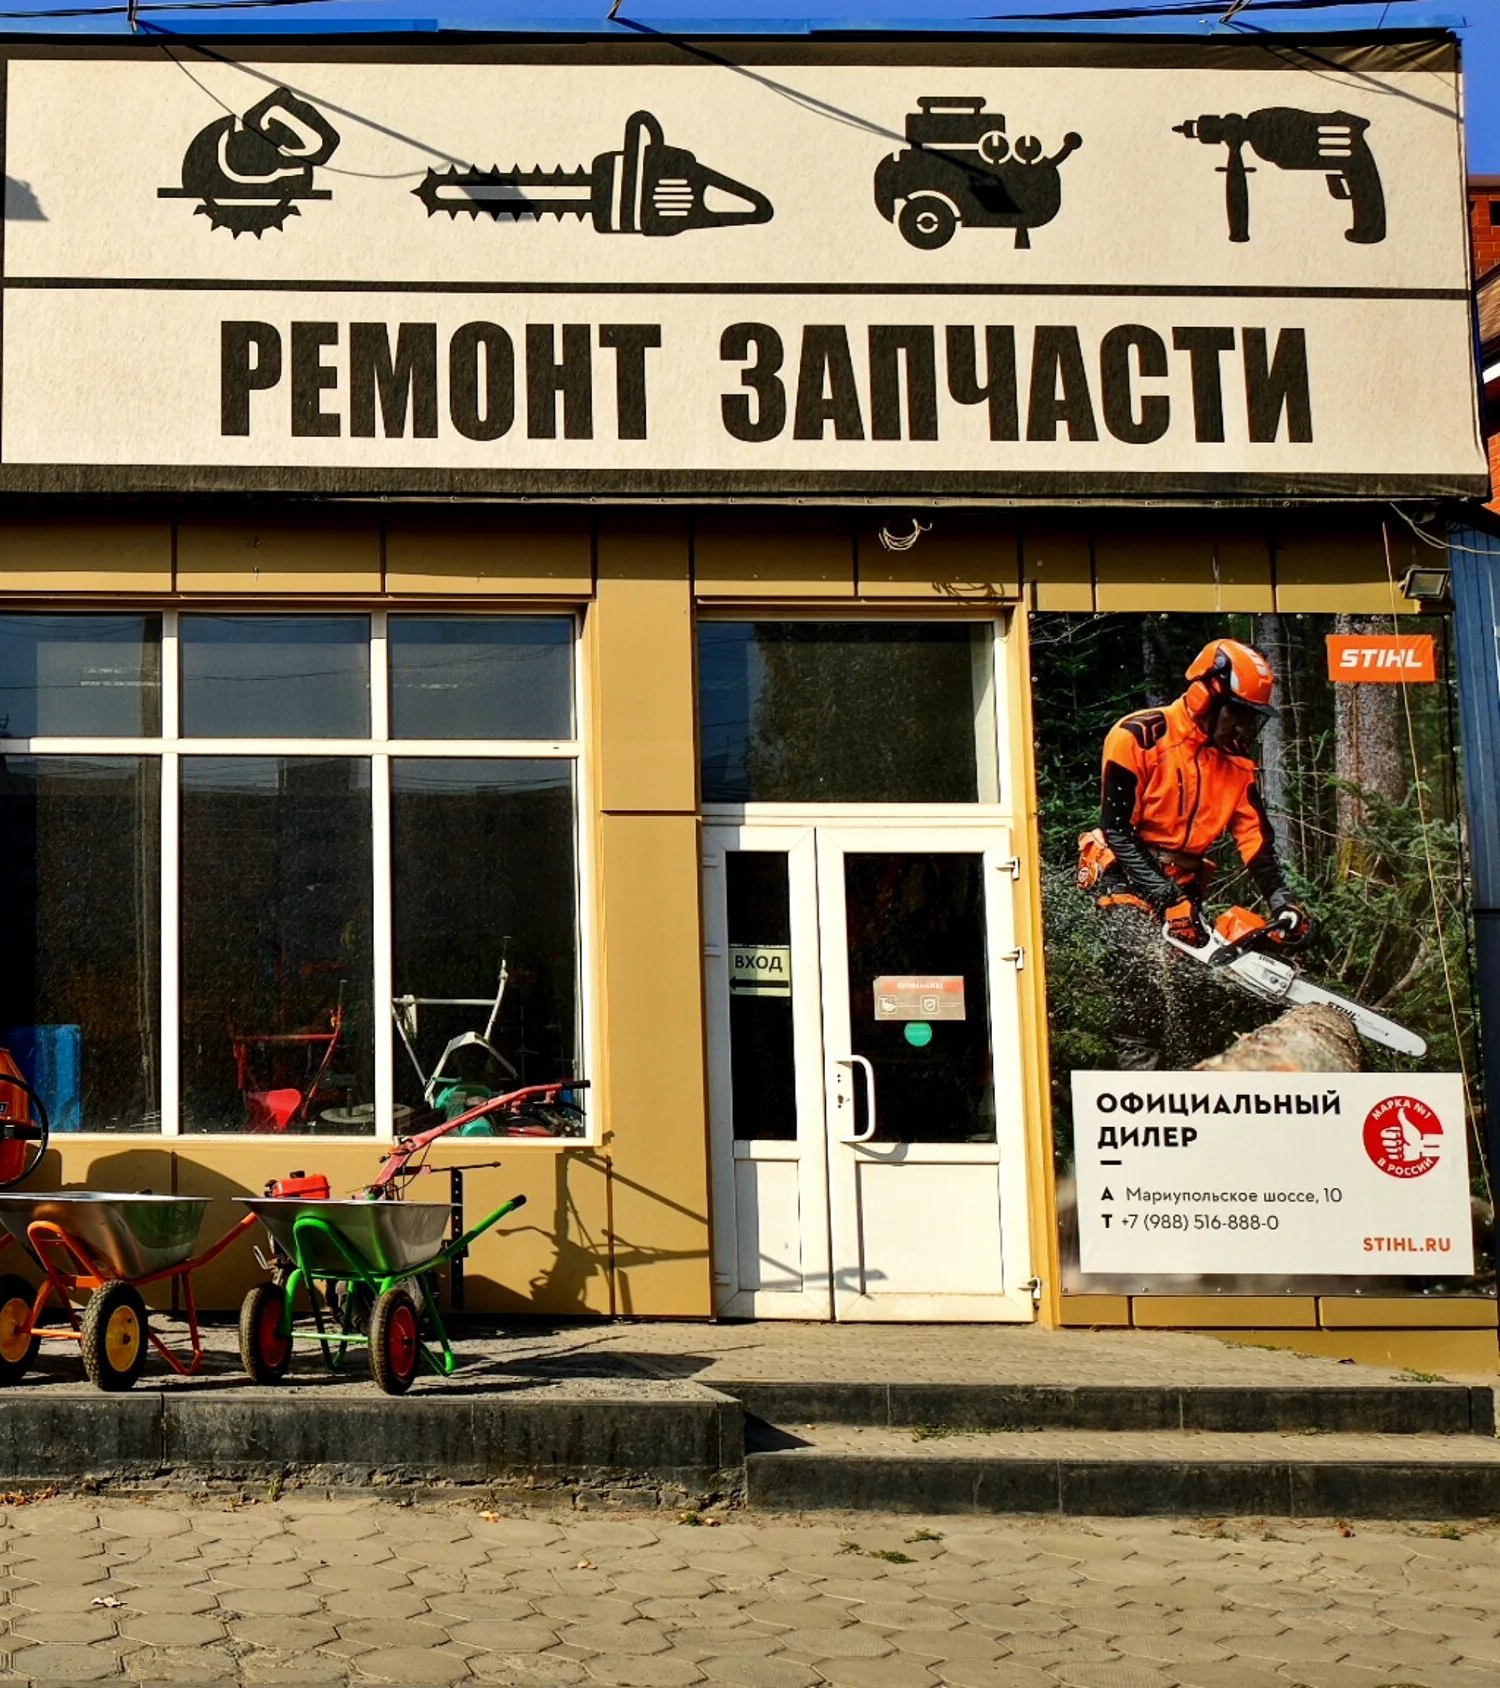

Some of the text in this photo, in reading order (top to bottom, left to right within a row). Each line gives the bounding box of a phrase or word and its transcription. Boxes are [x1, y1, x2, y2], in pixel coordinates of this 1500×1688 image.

[221, 320, 1314, 445] РЕМОНТ ЗАПЧАСТИ
[1340, 648, 1423, 668] STIHL
[735, 955, 783, 972] ВХОД
[1097, 1089, 1341, 1117] ОФИЦИАЛЬНЫЙ
[1371, 1098, 1433, 1120] МАРКА №1
[1097, 1126, 1198, 1150] ДИЛЕР
[1377, 1157, 1434, 1176] В РОССИИ
[1100, 1186, 1343, 1206] А Мариупольское шоссе, 10
[1100, 1213, 1280, 1232] Т +7 (988) 516-888-0
[1363, 1237, 1451, 1252] STIHL.RU
